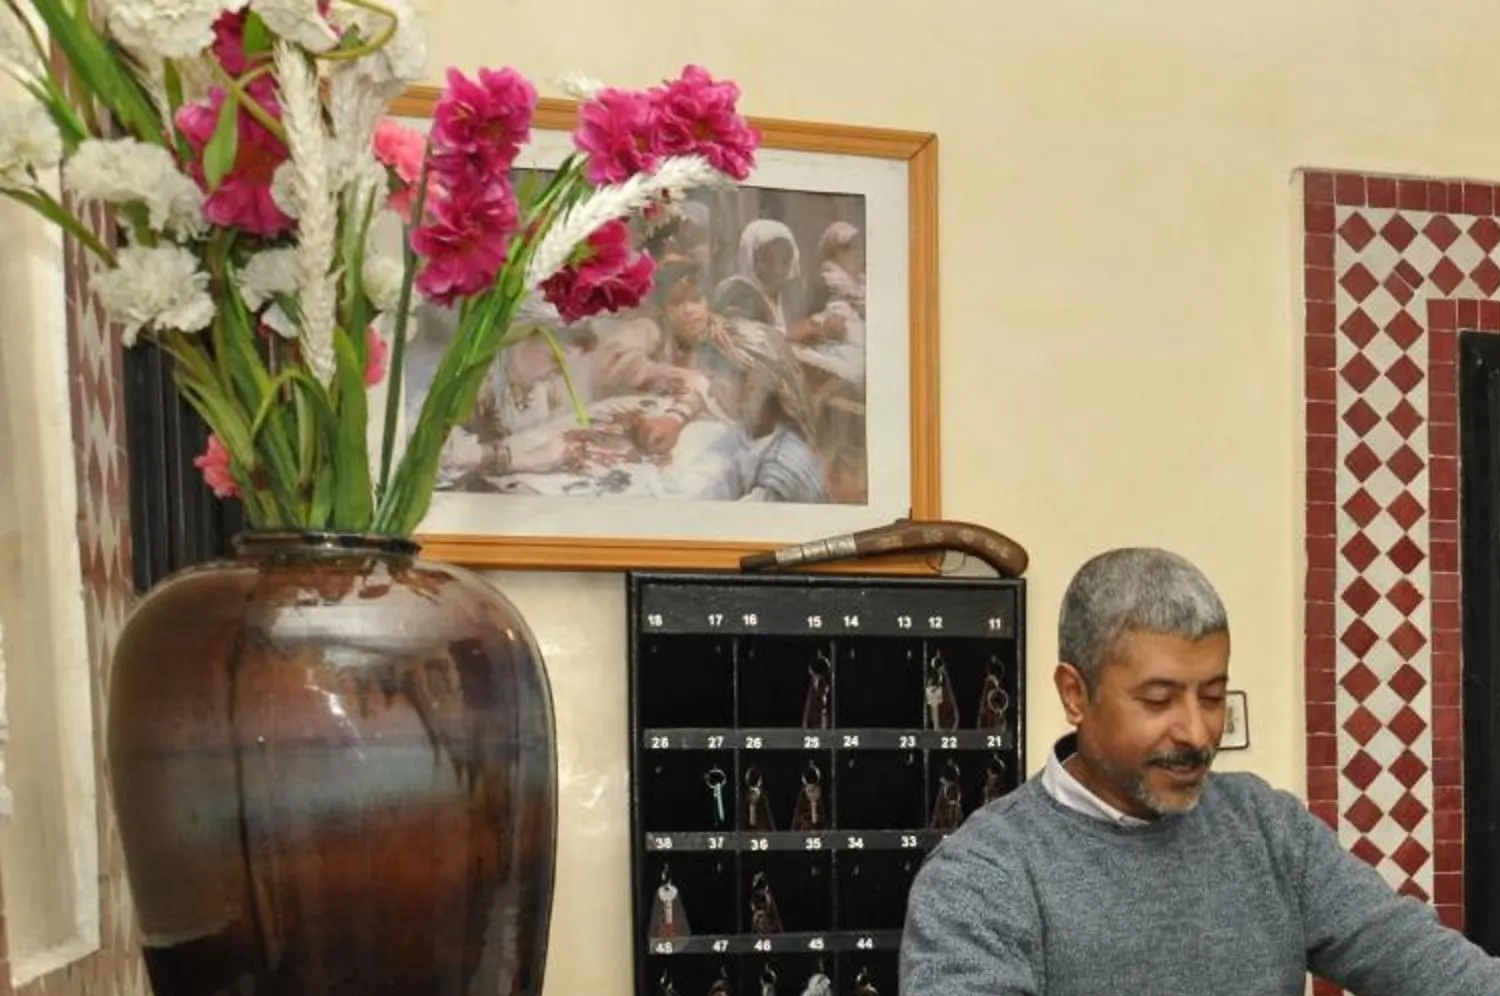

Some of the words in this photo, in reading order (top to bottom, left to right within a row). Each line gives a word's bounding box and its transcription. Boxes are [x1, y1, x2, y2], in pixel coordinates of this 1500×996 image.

[708, 614, 723, 625] 17
[743, 613, 757, 626] 16
[807, 615, 822, 628] 15
[843, 615, 859, 627] 14
[897, 616, 912, 628] 13
[928, 616, 943, 629] 12
[989, 618, 1001, 629] 11
[707, 735, 724, 749] 27
[745, 736, 762, 749] 26
[804, 736, 820, 749] 25
[843, 735, 859, 747] 24
[899, 735, 916, 748] 23
[941, 736, 957, 749] 22
[987, 735, 1001, 747] 21
[709, 836, 724, 849] 37
[751, 838, 769, 851] 36
[805, 837, 822, 850] 35
[848, 837, 864, 849] 34
[901, 835, 917, 847] 33
[713, 939, 729, 952] 47
[754, 939, 771, 951] 46
[809, 938, 824, 950] 45
[857, 938, 873, 949] 44
